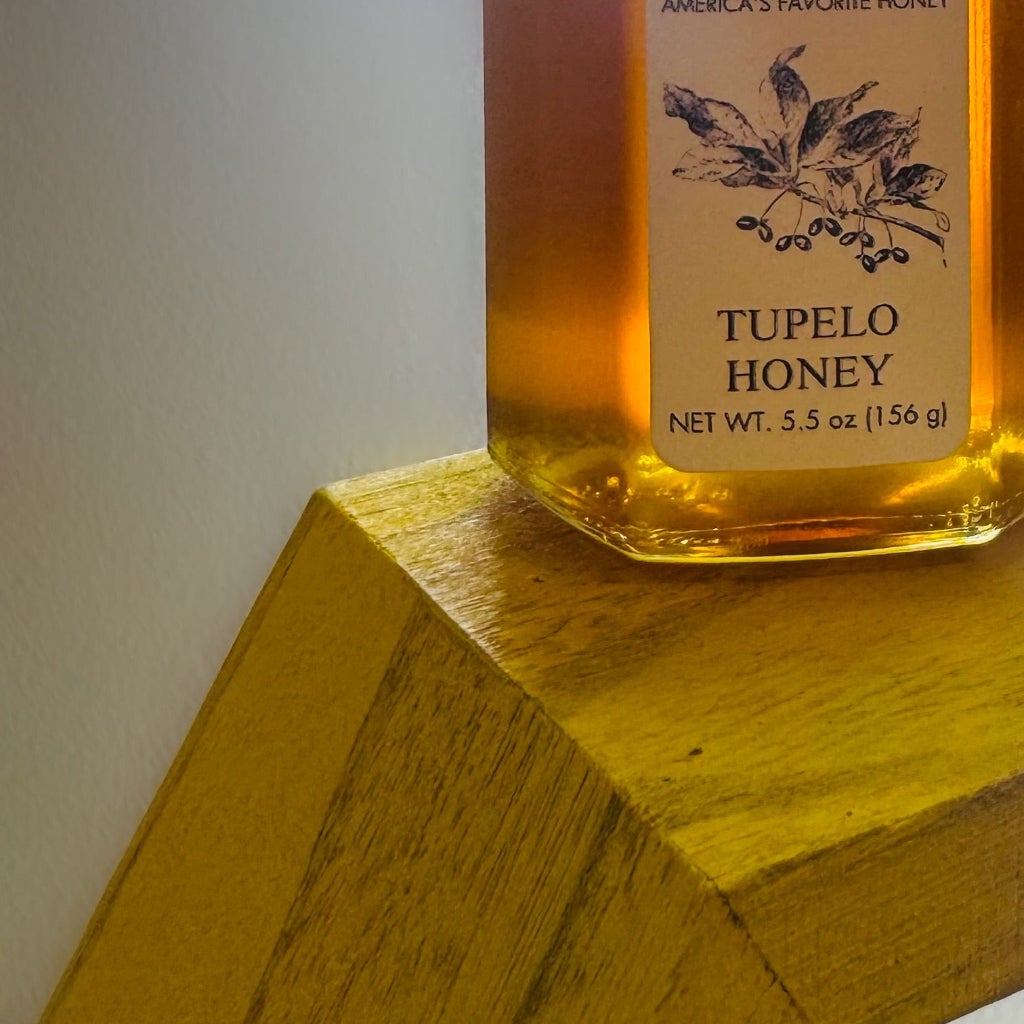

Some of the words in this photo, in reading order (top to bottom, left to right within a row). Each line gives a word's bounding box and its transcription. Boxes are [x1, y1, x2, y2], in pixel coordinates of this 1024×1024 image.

[717, 303, 899, 342] TUPELO
[726, 353, 894, 393] HONEY
[669, 412, 717, 434] NET
[724, 411, 772, 433] WT.
[781, 409, 820, 432] 5.5
[829, 414, 858, 430] oz
[865, 403, 919, 433] (156
[926, 401, 948, 429] g)
